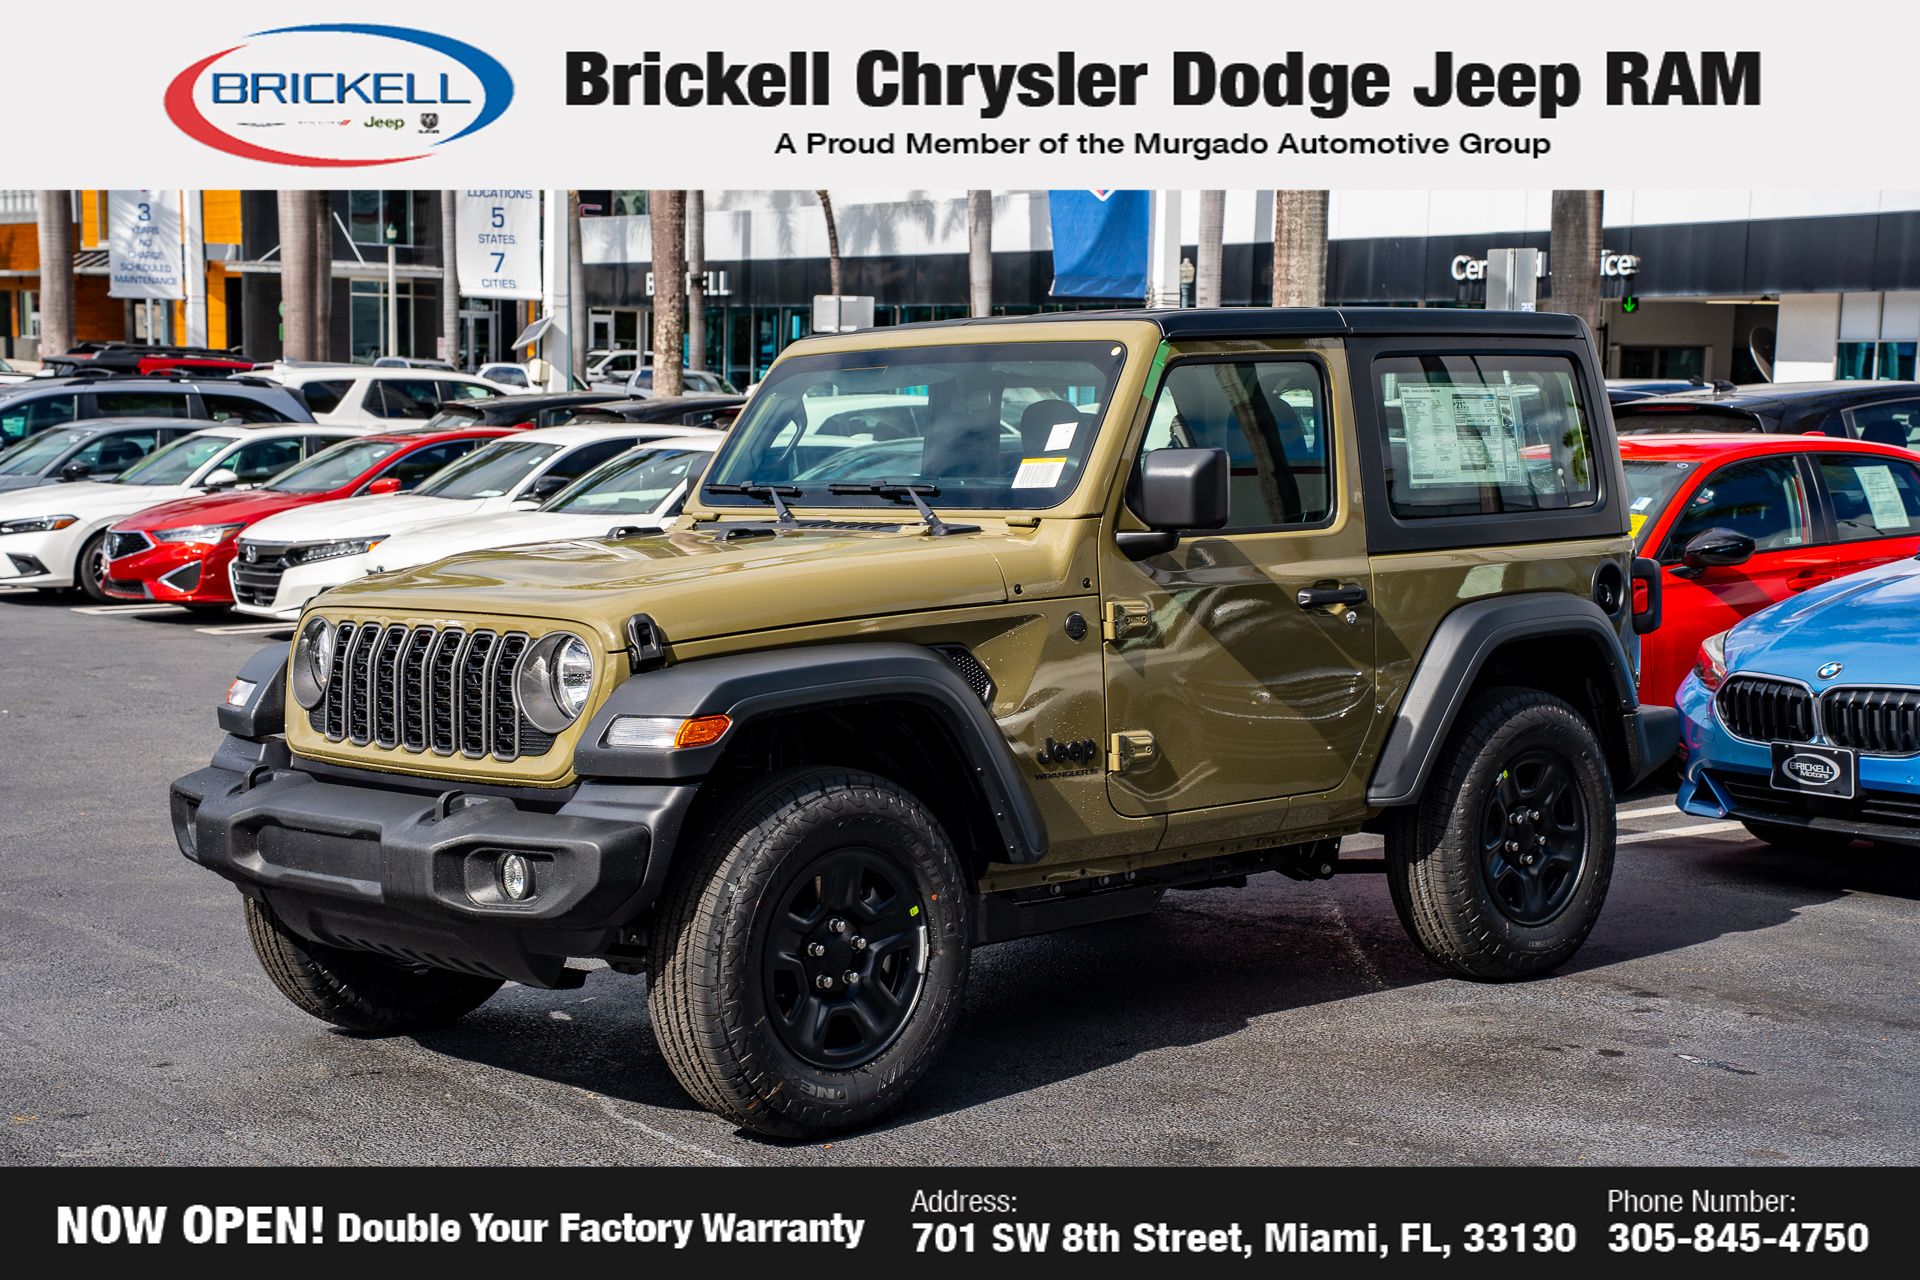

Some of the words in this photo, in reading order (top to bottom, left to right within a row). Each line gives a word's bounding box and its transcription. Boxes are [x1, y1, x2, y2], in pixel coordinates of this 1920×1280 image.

[138, 203, 151, 221] 3
[491, 206, 505, 228] 5
[139, 238, 153, 248] NO
[120, 262, 171, 273] SCHEDULED
[490, 252, 505, 273] 7
[114, 275, 177, 285] MAINTENANCE
[1036, 737, 1097, 765] Jeep
[1789, 761, 1833, 775] BRICKELL
[1035, 769, 1089, 780] WRANGLER
[1800, 770, 1829, 779] Motors
